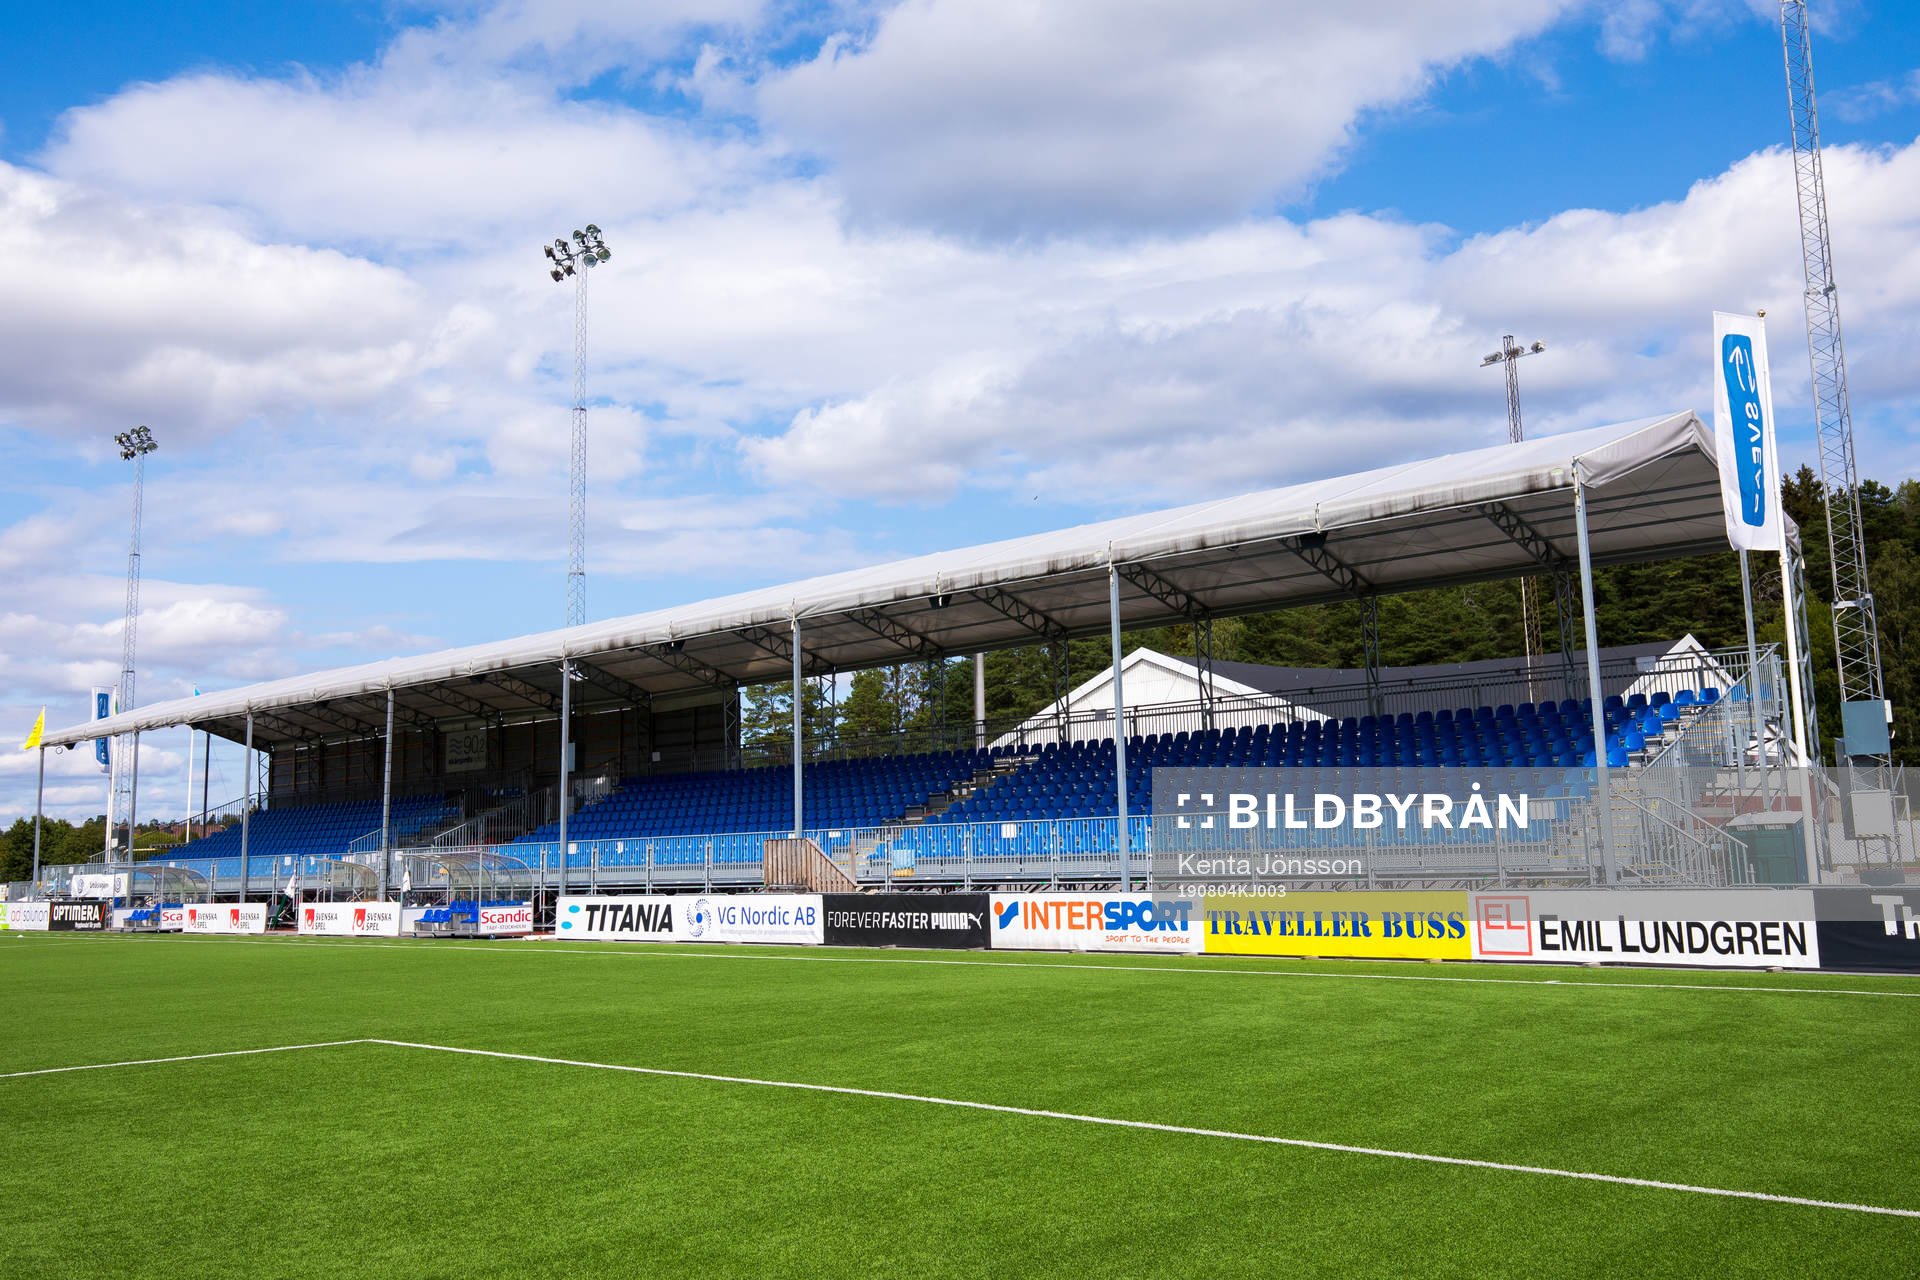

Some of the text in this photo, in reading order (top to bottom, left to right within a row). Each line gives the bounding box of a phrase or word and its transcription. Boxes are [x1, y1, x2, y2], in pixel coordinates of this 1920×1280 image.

[53, 905, 100, 921] OPTIMERA
[197, 913, 218, 921] SVENSKA
[240, 913, 260, 921] SVENSKA
[315, 912, 338, 921] SVENSKA
[366, 912, 392, 921] SVENSKA
[481, 909, 532, 924] Scandic
[585, 903, 674, 933] TITANIA
[718, 905, 816, 926] VG Nordic AB
[1024, 900, 1193, 932] INTERSPORT
[1483, 903, 1526, 930] EL
[197, 921, 207, 929] SPEL
[240, 921, 250, 929] SPEL
[315, 922, 326, 930] SPEL
[366, 922, 379, 931] SPEL
[1206, 910, 1466, 940] TRAVELLER BUSS
[1105, 934, 1191, 944] SPORT TO THE PEOPLE
[1539, 914, 1808, 956] EMIL LUNDGREN
